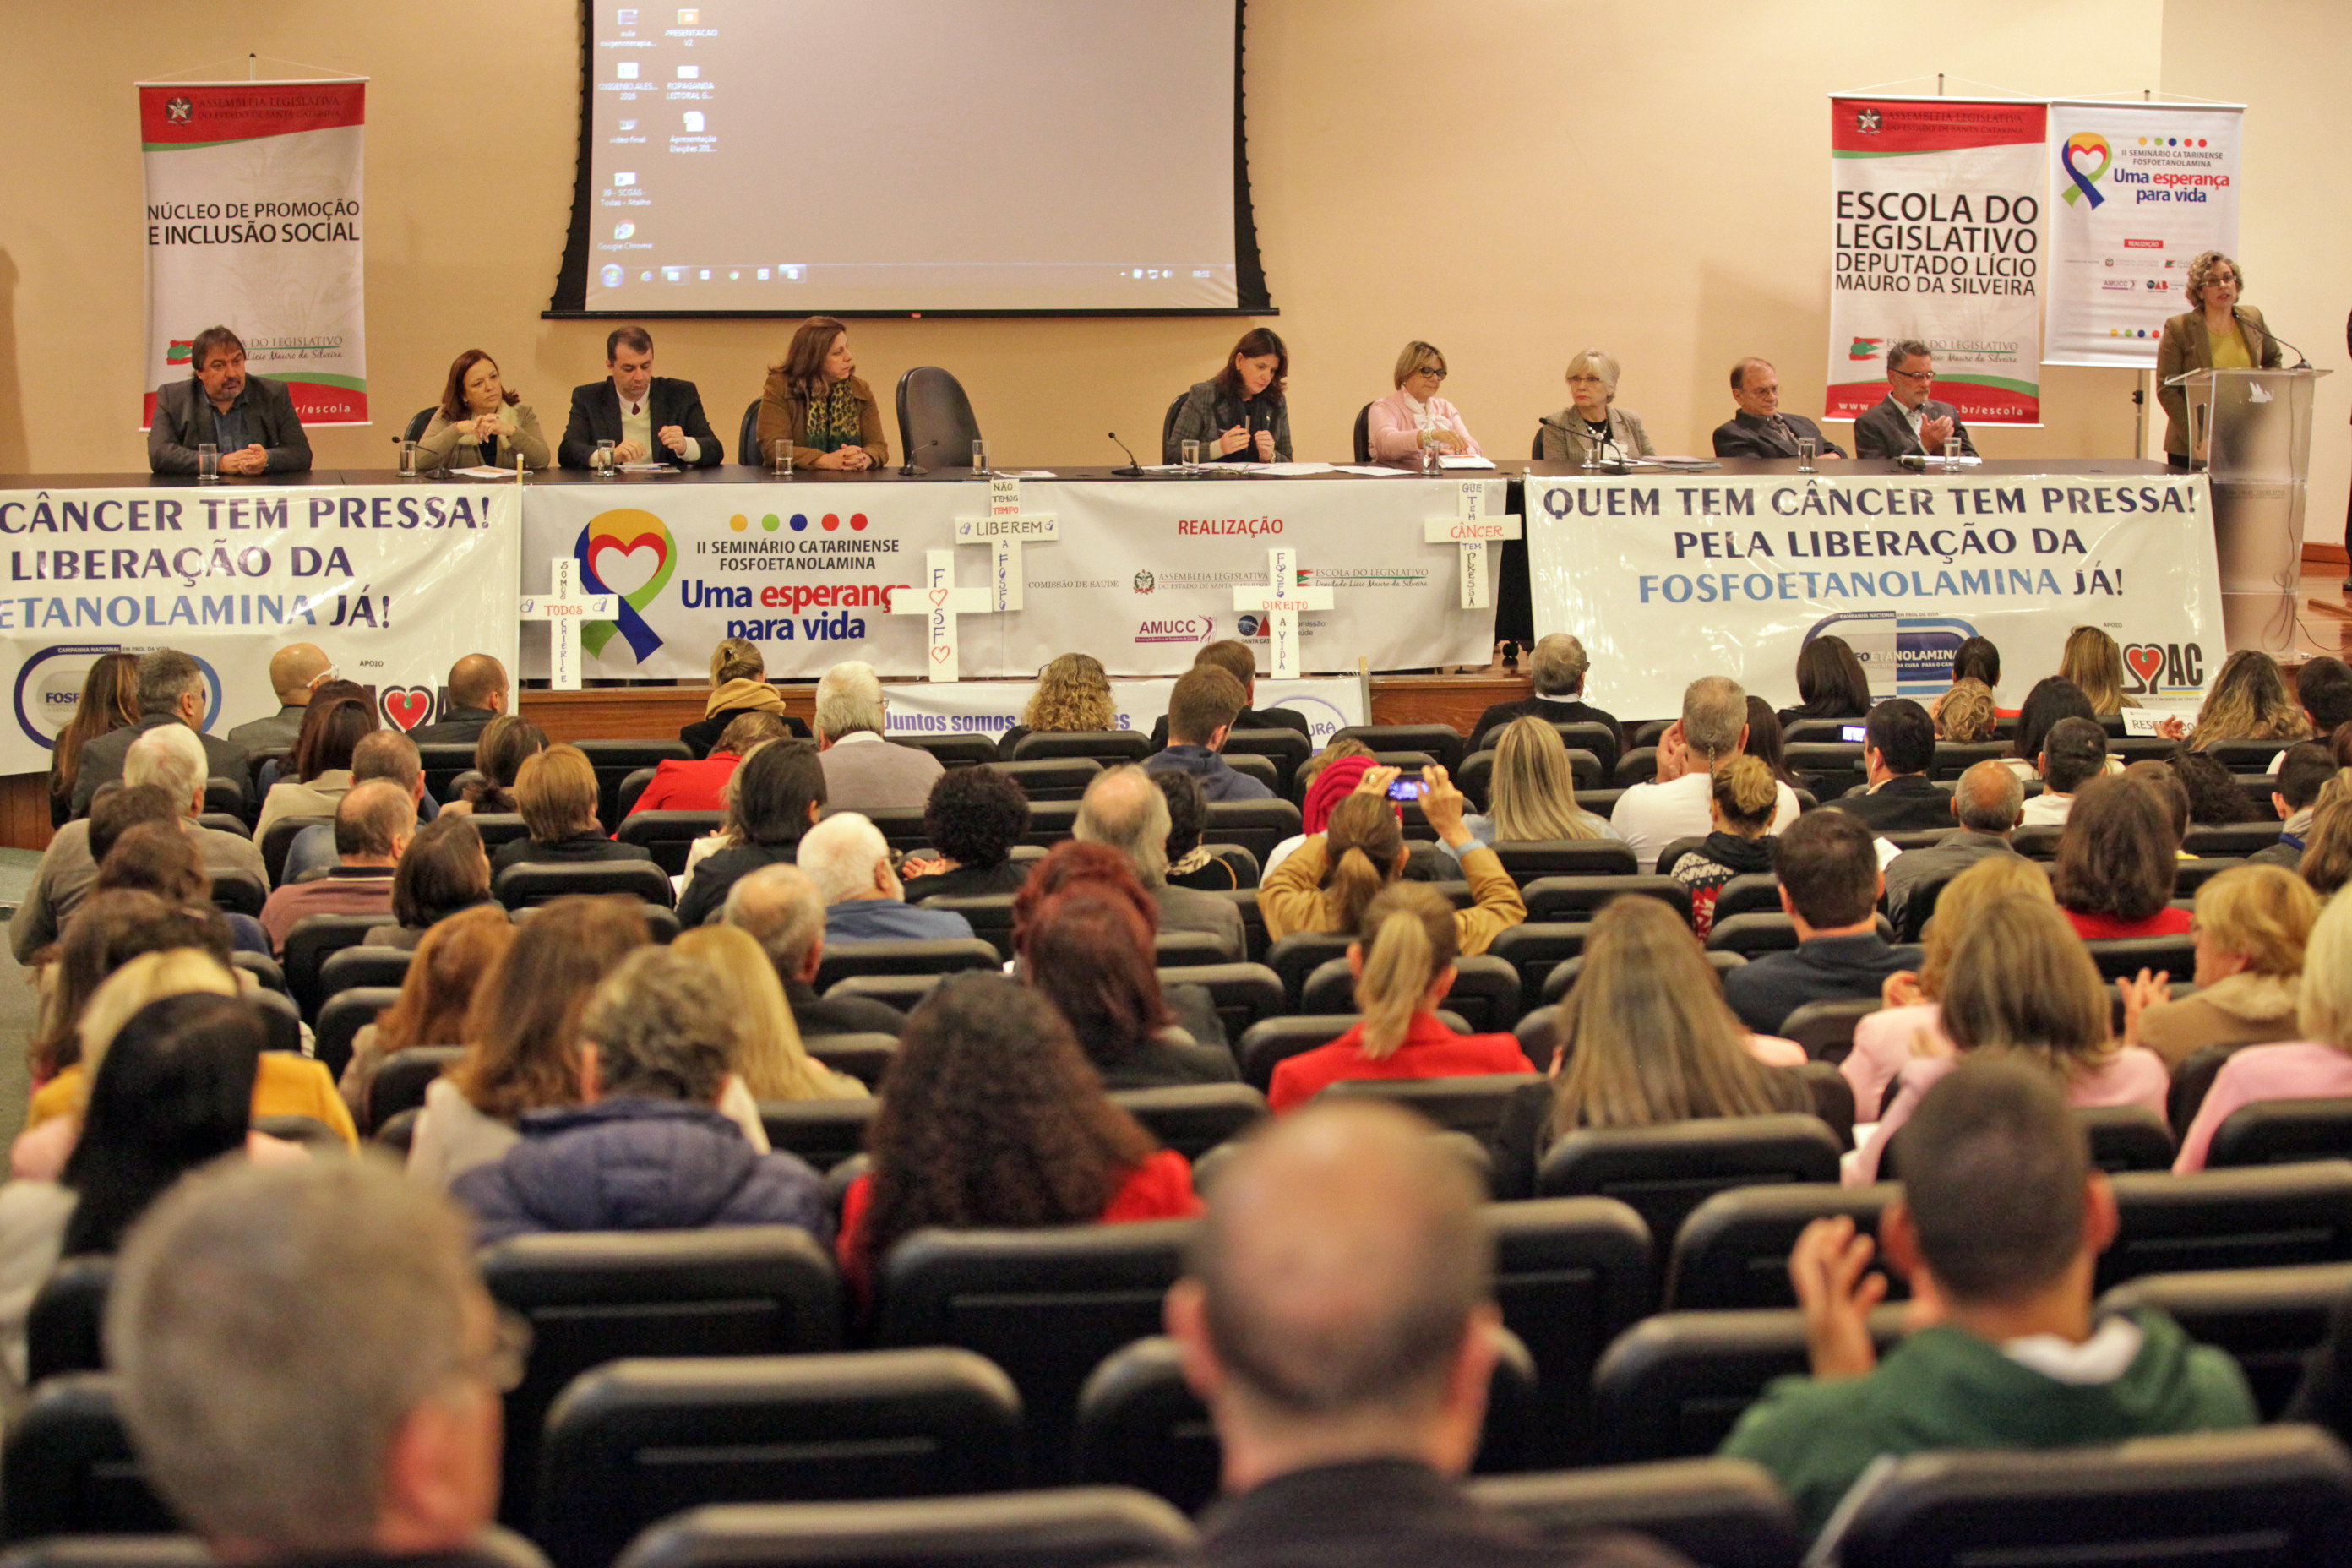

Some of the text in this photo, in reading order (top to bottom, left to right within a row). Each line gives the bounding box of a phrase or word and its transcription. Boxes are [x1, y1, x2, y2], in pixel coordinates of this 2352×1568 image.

[2129, 149, 2171, 158] SEMINÁRIO
[2133, 159, 2211, 167] FOSFOETANOLAMINA
[2114, 168, 2230, 190] Uma esperança
[2137, 188, 2207, 204] para vida
[148, 199, 359, 220] NÚCLEO DE PROMOÇÃO
[1838, 191, 2038, 225] ESCOLA DO
[149, 220, 360, 245] E INCLUSÃO SOCIAL
[1837, 223, 2037, 254] LEGISLATIVO
[597, 242, 623, 252] Google
[1836, 253, 2036, 277] DEPUTADO LÍCIO
[1836, 275, 2035, 296] MAURO DA SILVEIRA
[251, 339, 268, 347] DO
[273, 336, 343, 346] LEGISLATIVO
[1930, 340, 1946, 349] DO
[1951, 341, 2018, 351] LEGISLATIVO
[994, 482, 1013, 492] NÃO
[1544, 479, 2197, 520] QUEM TEM CÂNCER TEM PRESSA!
[0, 492, 489, 534] CÂNCER TEM PRESSA!
[993, 506, 1019, 514] TEMPO
[977, 521, 1043, 536] LIBEREM
[1179, 516, 1283, 538] REALIZAÇÃO
[1451, 521, 1504, 539] CÂNCER
[697, 541, 706, 554] II
[711, 538, 795, 554] SEMINÁRIO
[1002, 540, 1009, 548] A
[1462, 542, 1482, 551] TEM
[1674, 522, 2088, 564] PELA LIBERAÇÃO DA
[11, 538, 355, 587] LIBERAÇÃO DA
[720, 557, 875, 571] FOSFOETANOLAMINA
[1158, 571, 1268, 580] ASSEMBLEIA LEGISLATIVA
[1315, 569, 1350, 577] ESCOLA
[1353, 569, 1368, 577] DO
[1028, 579, 1119, 589] COMISSÃO DE SAÚDE
[1402, 578, 1429, 586] Silveira
[1639, 560, 2123, 603] FOSFOETANOLAMINA JÁ!
[681, 580, 912, 614] Uma esperanç
[329, 584, 390, 629] JÁ!
[544, 605, 583, 617] TODOS
[1262, 601, 1309, 611] DIREITO
[727, 611, 865, 640] para vida
[1139, 620, 1196, 634] AMUCC
[885, 711, 1015, 732] Juntos somos
